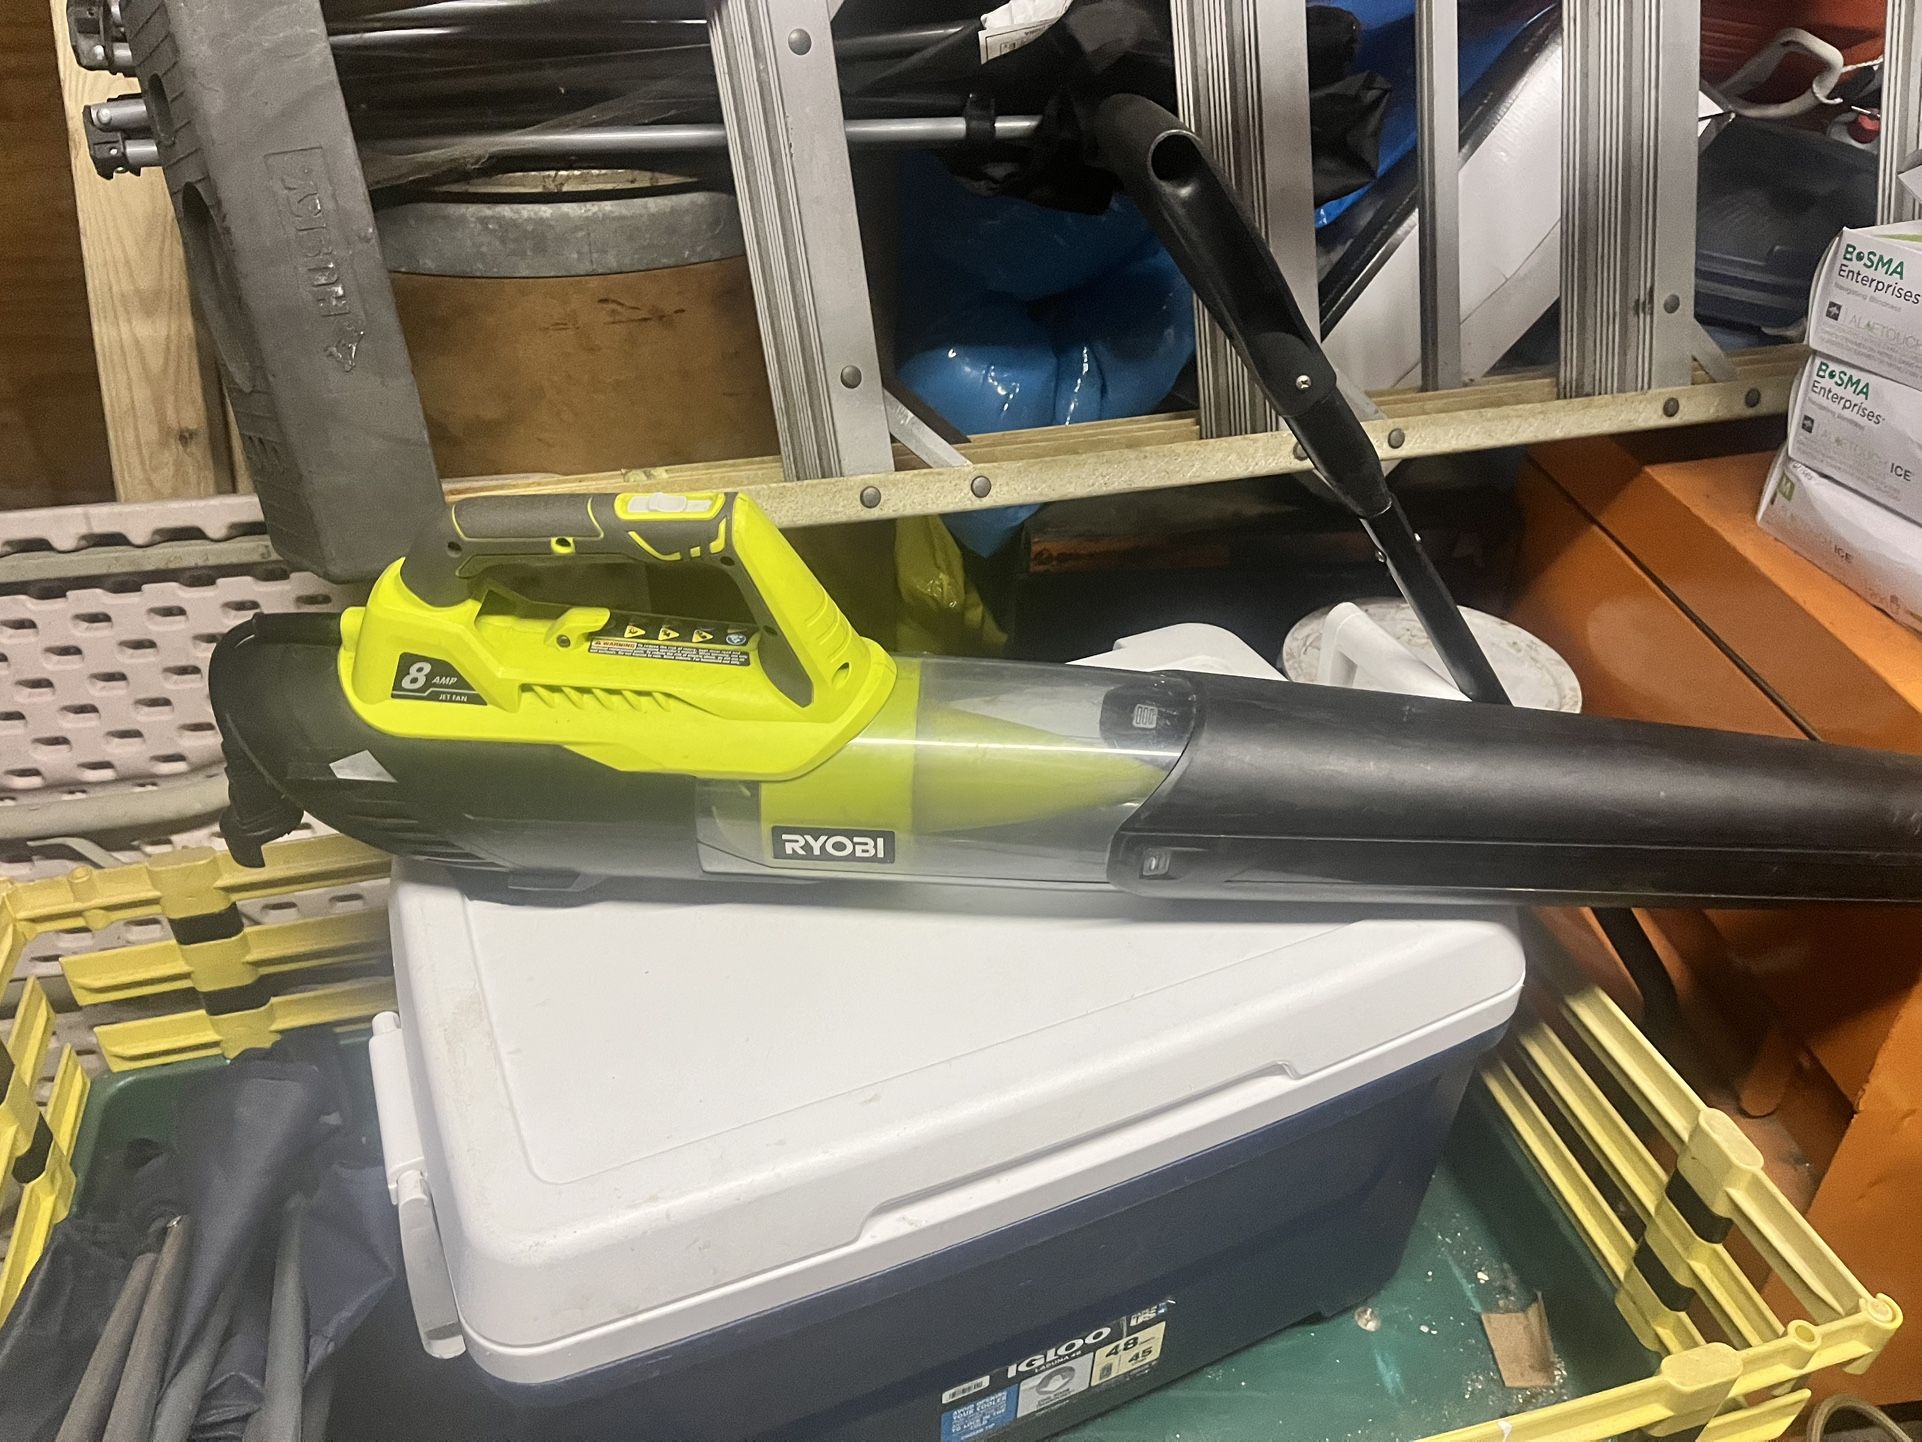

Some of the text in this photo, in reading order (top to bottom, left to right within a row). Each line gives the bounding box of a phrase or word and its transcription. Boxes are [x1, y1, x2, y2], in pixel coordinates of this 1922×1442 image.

[1838, 263, 1922, 305] Enterprises
[1810, 380, 1883, 426] Enterprises
[1889, 462, 1913, 482] ICE
[602, 640, 636, 649] WARNING
[401, 661, 458, 690] 8 AMP
[439, 693, 468, 703] JET FAN
[781, 834, 885, 858] RYOBI
[1007, 1327, 1112, 1379] IGLOO
[1105, 1336, 1140, 1359] 48
[1128, 1346, 1153, 1364] 45
